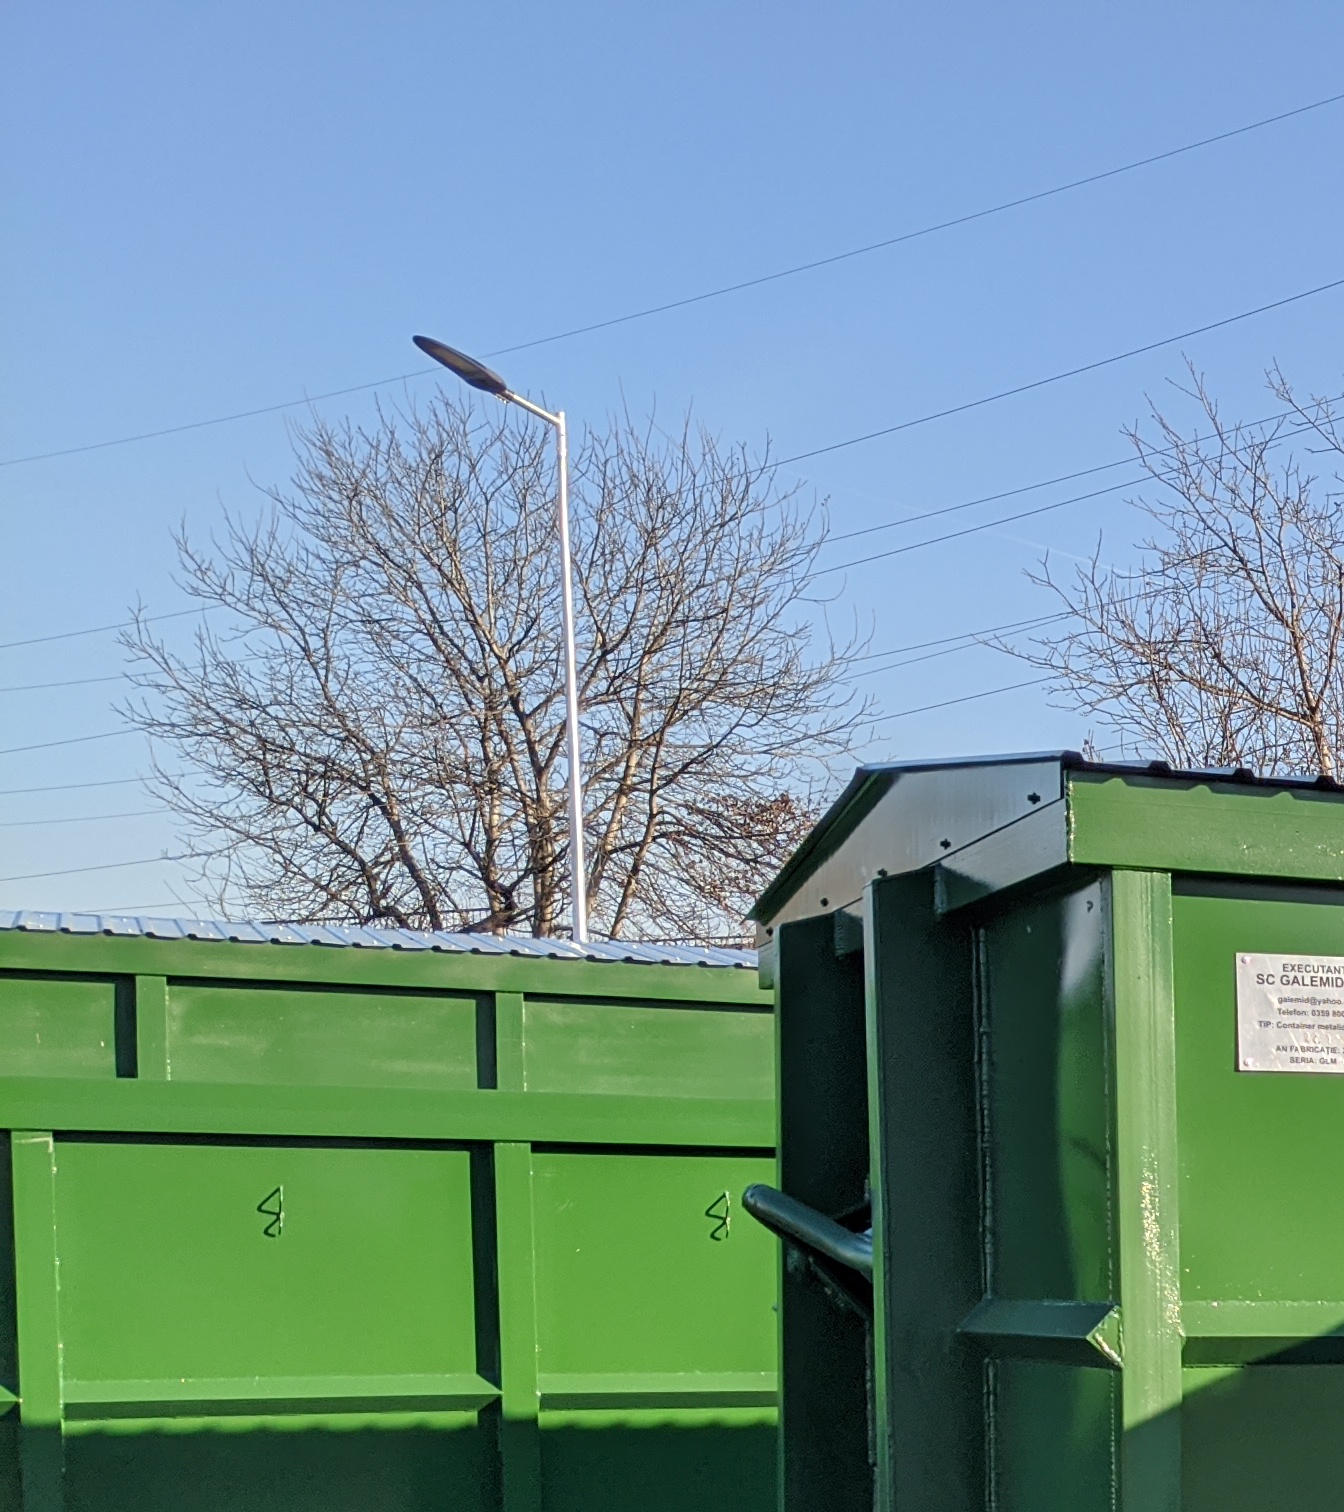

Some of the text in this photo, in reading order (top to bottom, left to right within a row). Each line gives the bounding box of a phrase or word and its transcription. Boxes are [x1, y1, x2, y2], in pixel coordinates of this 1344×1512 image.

[1256, 973, 1276, 985] SC
[1280, 974, 1344, 988] GALEMID
[1277, 1008, 1309, 1017] Telefon:
[1258, 1020, 1274, 1029] TIP:
[1276, 1021, 1315, 1030] Container
[1289, 1057, 1317, 1065] SERIA:
